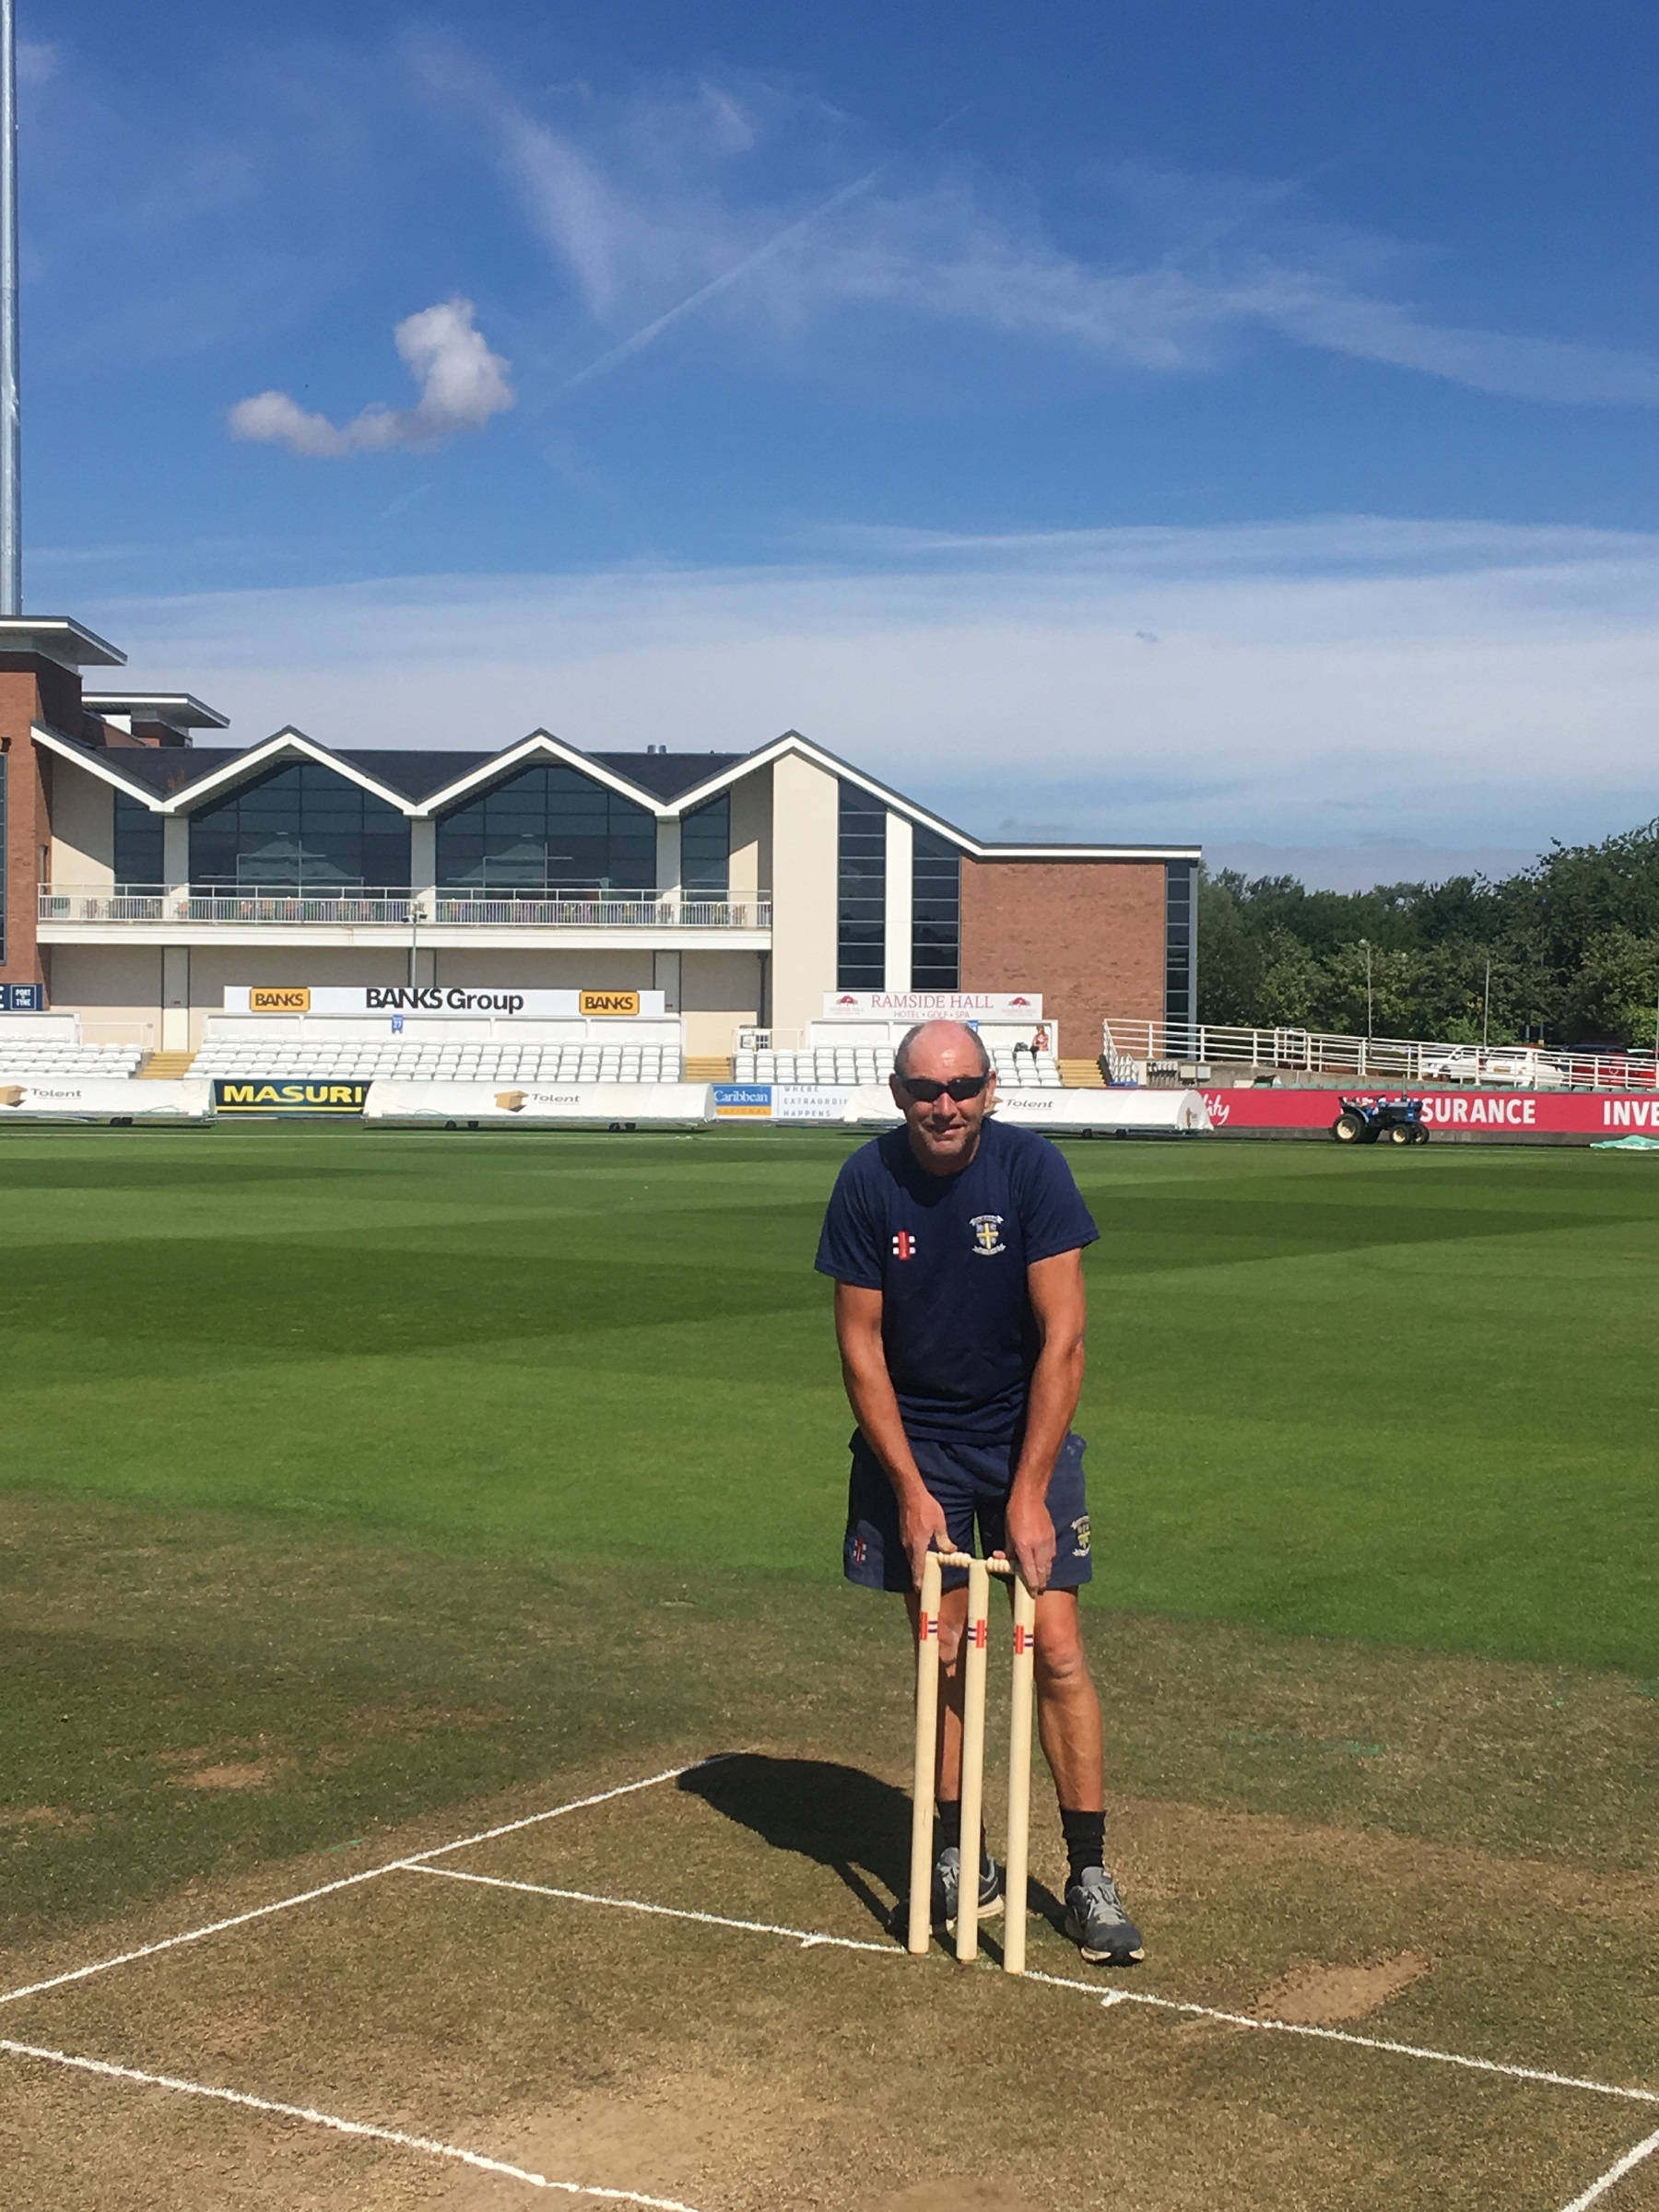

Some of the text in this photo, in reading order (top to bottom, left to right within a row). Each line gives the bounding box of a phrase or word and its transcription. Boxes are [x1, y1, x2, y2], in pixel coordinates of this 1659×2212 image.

[255, 994, 304, 1006] BANKS
[366, 988, 524, 1014] BANKS Group
[584, 996, 634, 1010] BANKS
[871, 994, 994, 1008] RAMSIDE HALL
[30, 1088, 82, 1098] Tolent
[223, 1085, 362, 1103] MASURI
[532, 1093, 581, 1103] Tolent
[714, 1089, 769, 1102] Caribbean
[1006, 1099, 1053, 1108] Tolent
[1604, 1100, 1659, 1126] INVE
